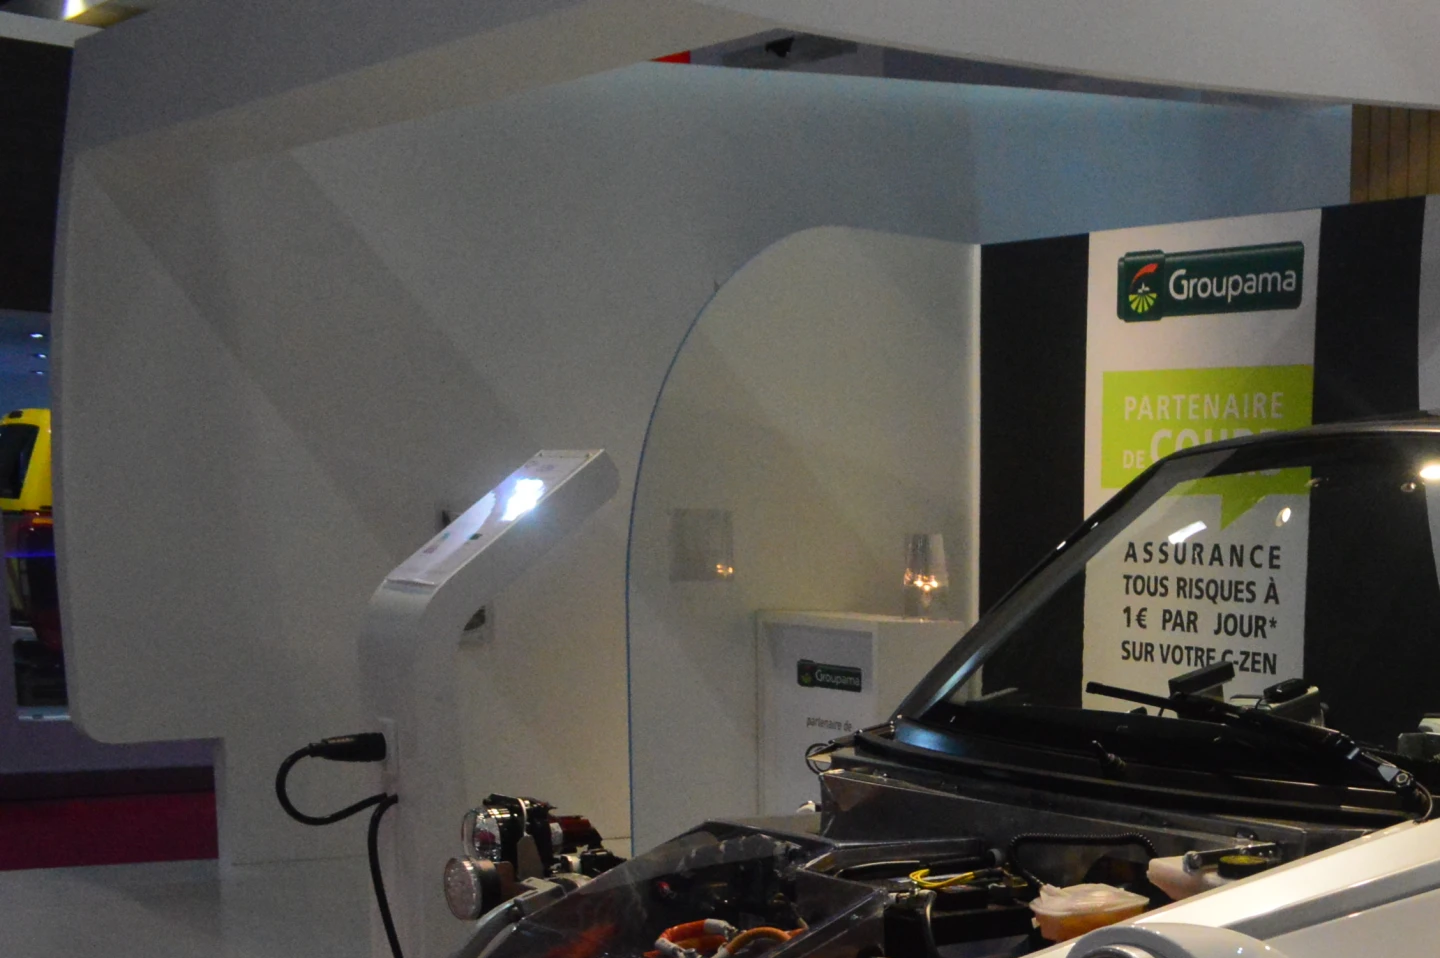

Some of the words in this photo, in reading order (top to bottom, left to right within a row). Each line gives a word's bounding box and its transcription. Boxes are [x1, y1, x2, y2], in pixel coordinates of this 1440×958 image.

[1169, 269, 1296, 302] Groupama
[1124, 392, 1284, 420] PARTENAIRE
[1123, 450, 1145, 469] DE
[1124, 541, 1281, 569] ASSURANCE
[1123, 574, 1168, 597] TOUS
[1176, 577, 1256, 604] RISQUES
[1264, 577, 1280, 605] À
[1162, 609, 1198, 633] PAR
[1121, 640, 1154, 663] SUR
[1159, 643, 1216, 669] VOTRE
[1221, 649, 1277, 675] C-ZEN
[815, 669, 860, 686] Groupama
